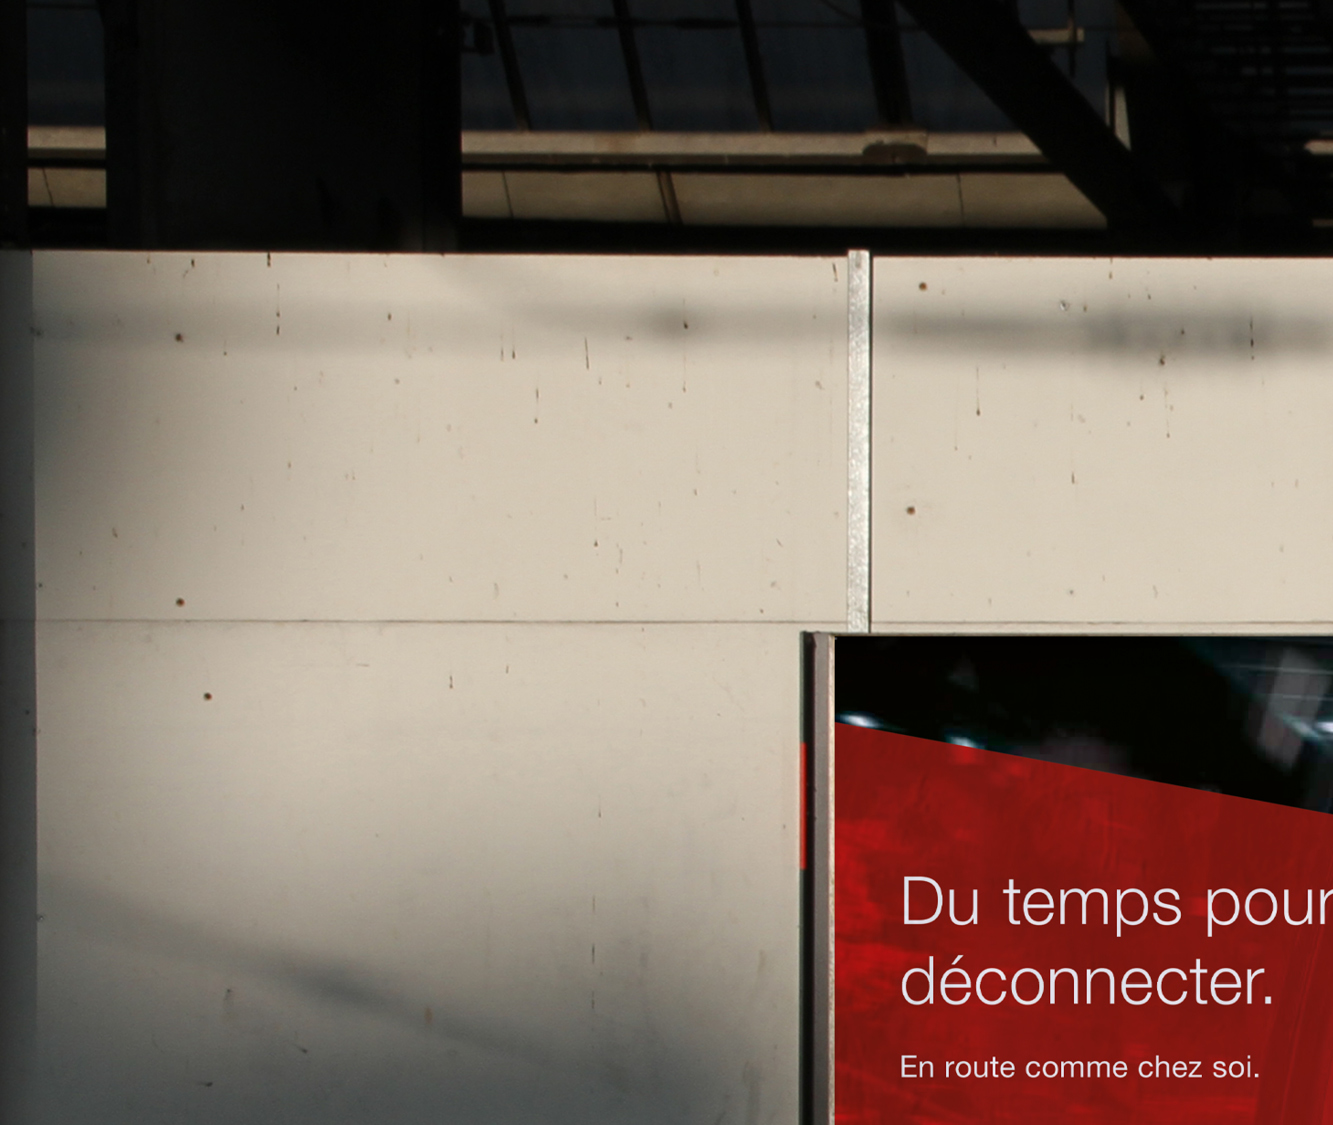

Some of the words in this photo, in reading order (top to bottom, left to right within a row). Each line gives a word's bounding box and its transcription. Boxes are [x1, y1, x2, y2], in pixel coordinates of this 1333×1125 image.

[902, 874, 979, 926] Du
[1002, 878, 1183, 938] temps
[901, 954, 1272, 1006] déconnecter.
[901, 1054, 934, 1079] En
[945, 1056, 1016, 1079] route
[1025, 1060, 1128, 1079] comme
[1138, 1054, 1203, 1079] chez
[1213, 1054, 1259, 1079] soi.
